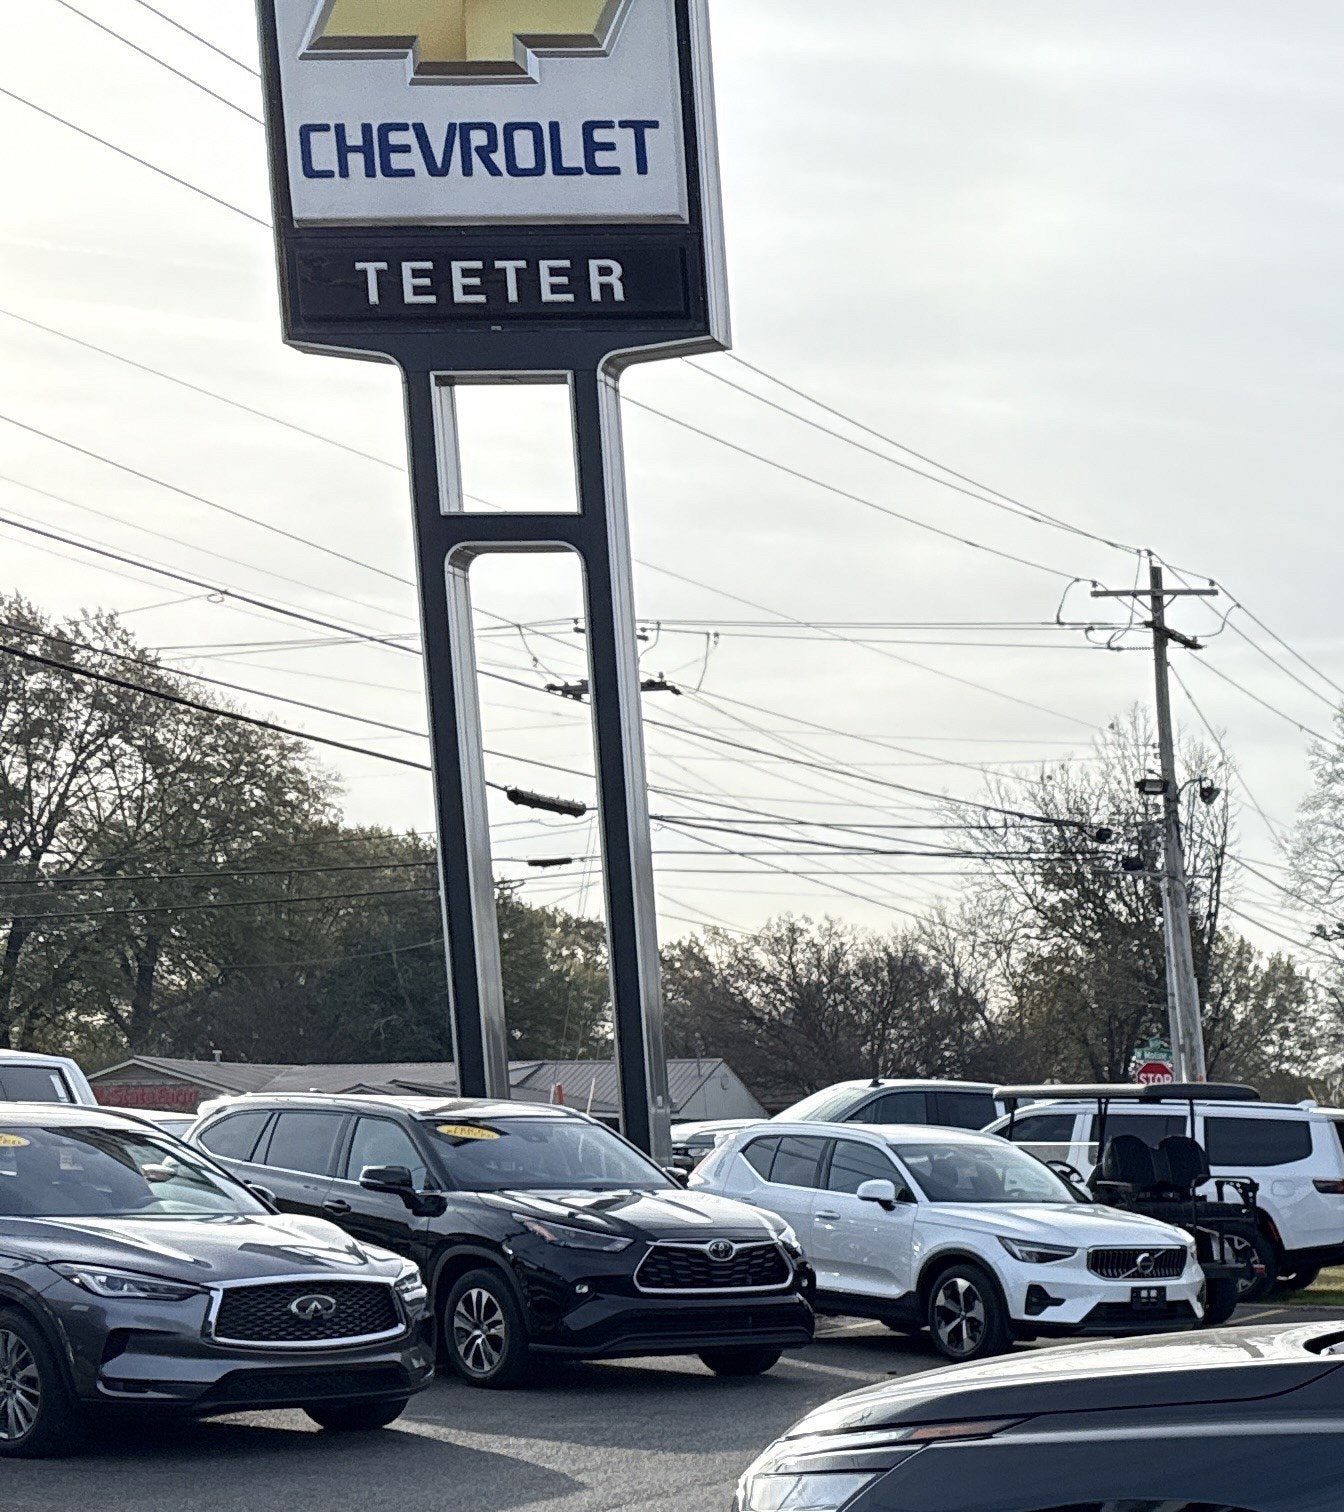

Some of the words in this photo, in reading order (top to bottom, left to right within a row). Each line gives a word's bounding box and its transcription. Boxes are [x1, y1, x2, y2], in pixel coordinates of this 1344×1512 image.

[298, 119, 660, 179] CHEVROLET
[354, 258, 626, 305] TEETER
[1139, 1072, 1173, 1085] STOP
